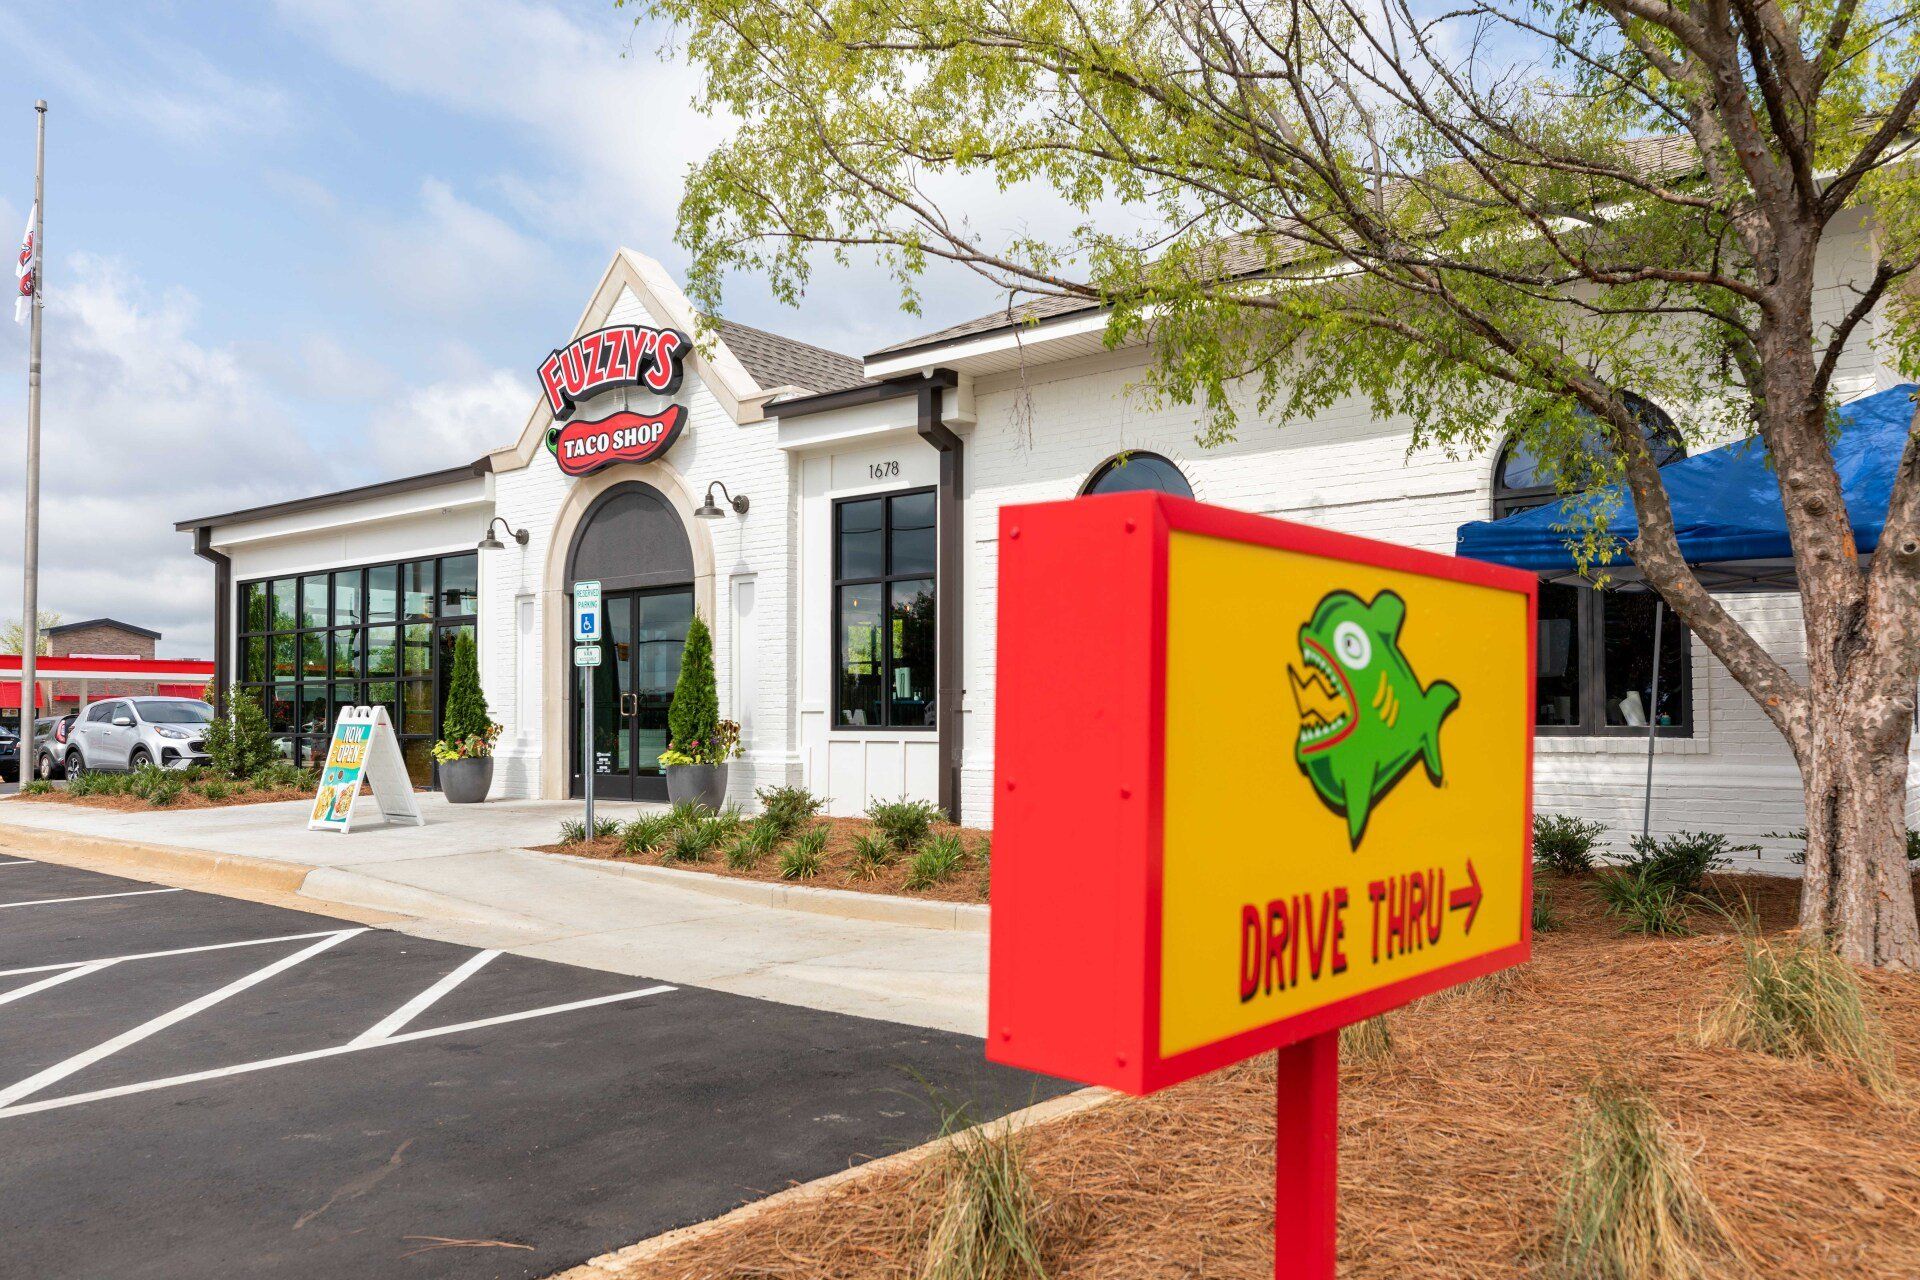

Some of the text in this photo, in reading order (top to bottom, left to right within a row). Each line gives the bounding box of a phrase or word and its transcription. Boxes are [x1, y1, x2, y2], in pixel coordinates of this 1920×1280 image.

[540, 327, 681, 414] FUZZY'S
[564, 422, 664, 459] TACO SHOP
[869, 460, 899, 479] 1678
[576, 589, 599, 598] RESERVED
[342, 726, 365, 743] NOW
[336, 745, 359, 763] OPEN
[1239, 867, 1444, 1004] DRIVE THRU
